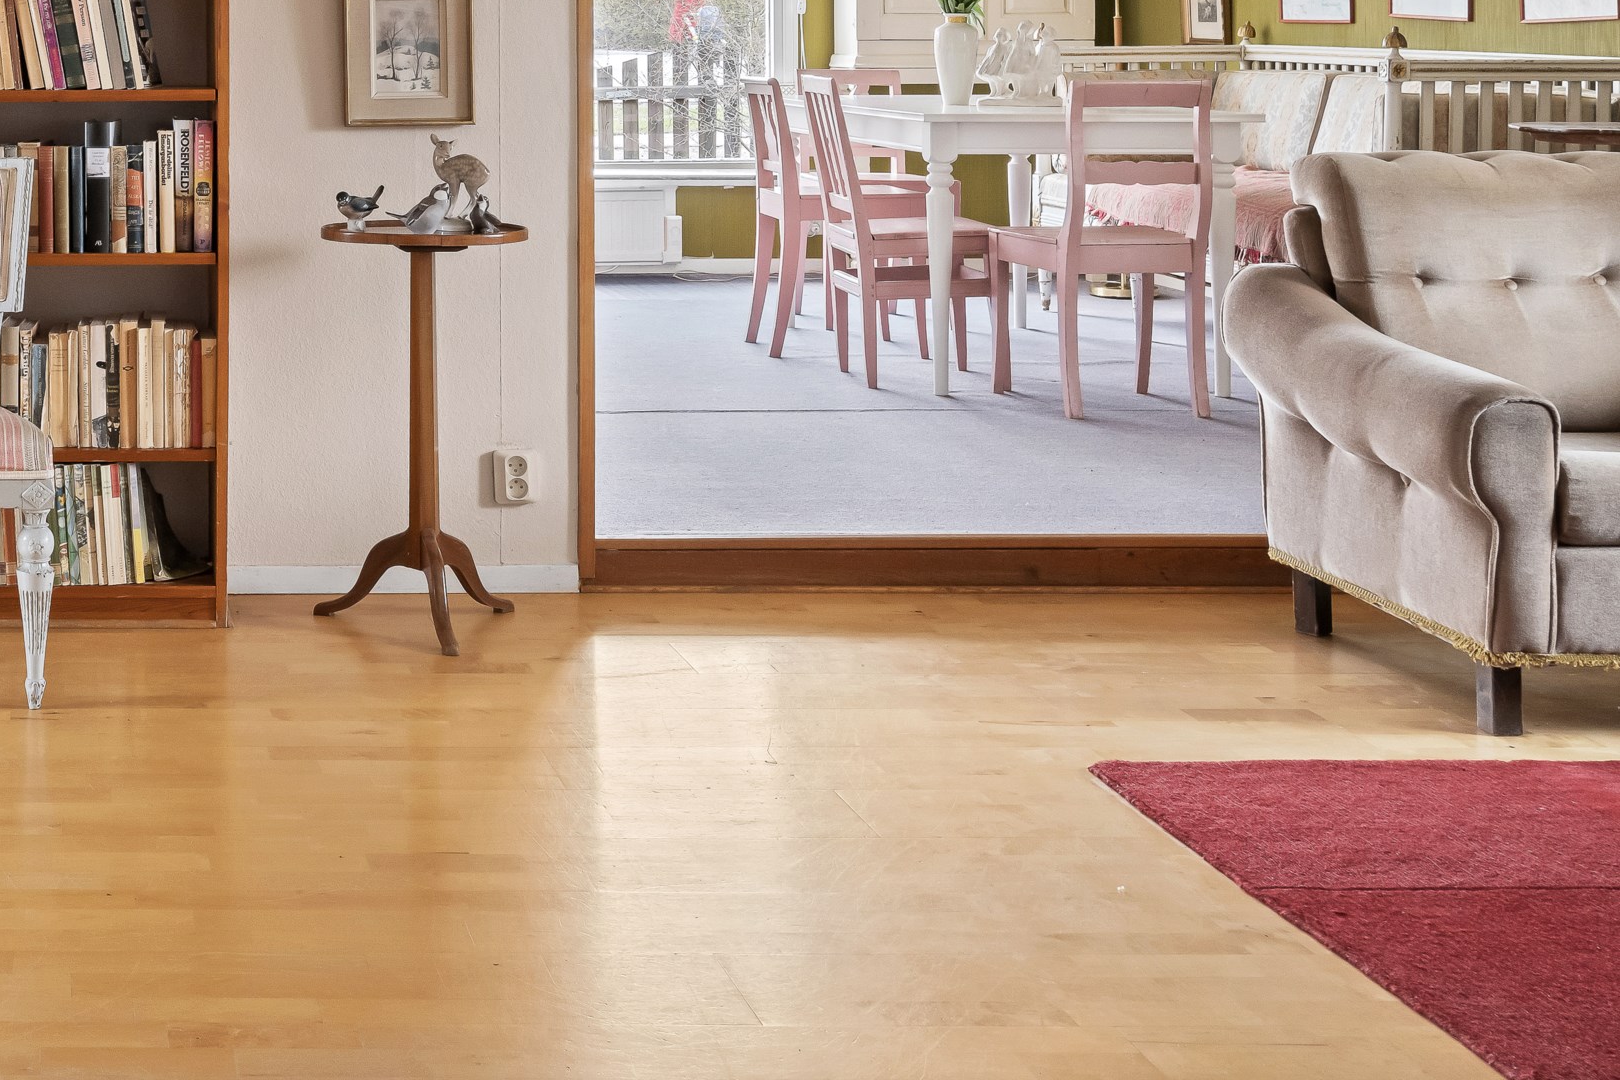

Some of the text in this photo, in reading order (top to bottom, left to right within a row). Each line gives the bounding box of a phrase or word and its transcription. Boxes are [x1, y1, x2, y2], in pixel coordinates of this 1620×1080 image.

[78, 4, 87, 27] Persson
[166, 151, 174, 180] Ardelius
[180, 130, 190, 195] ROSENFELDT
